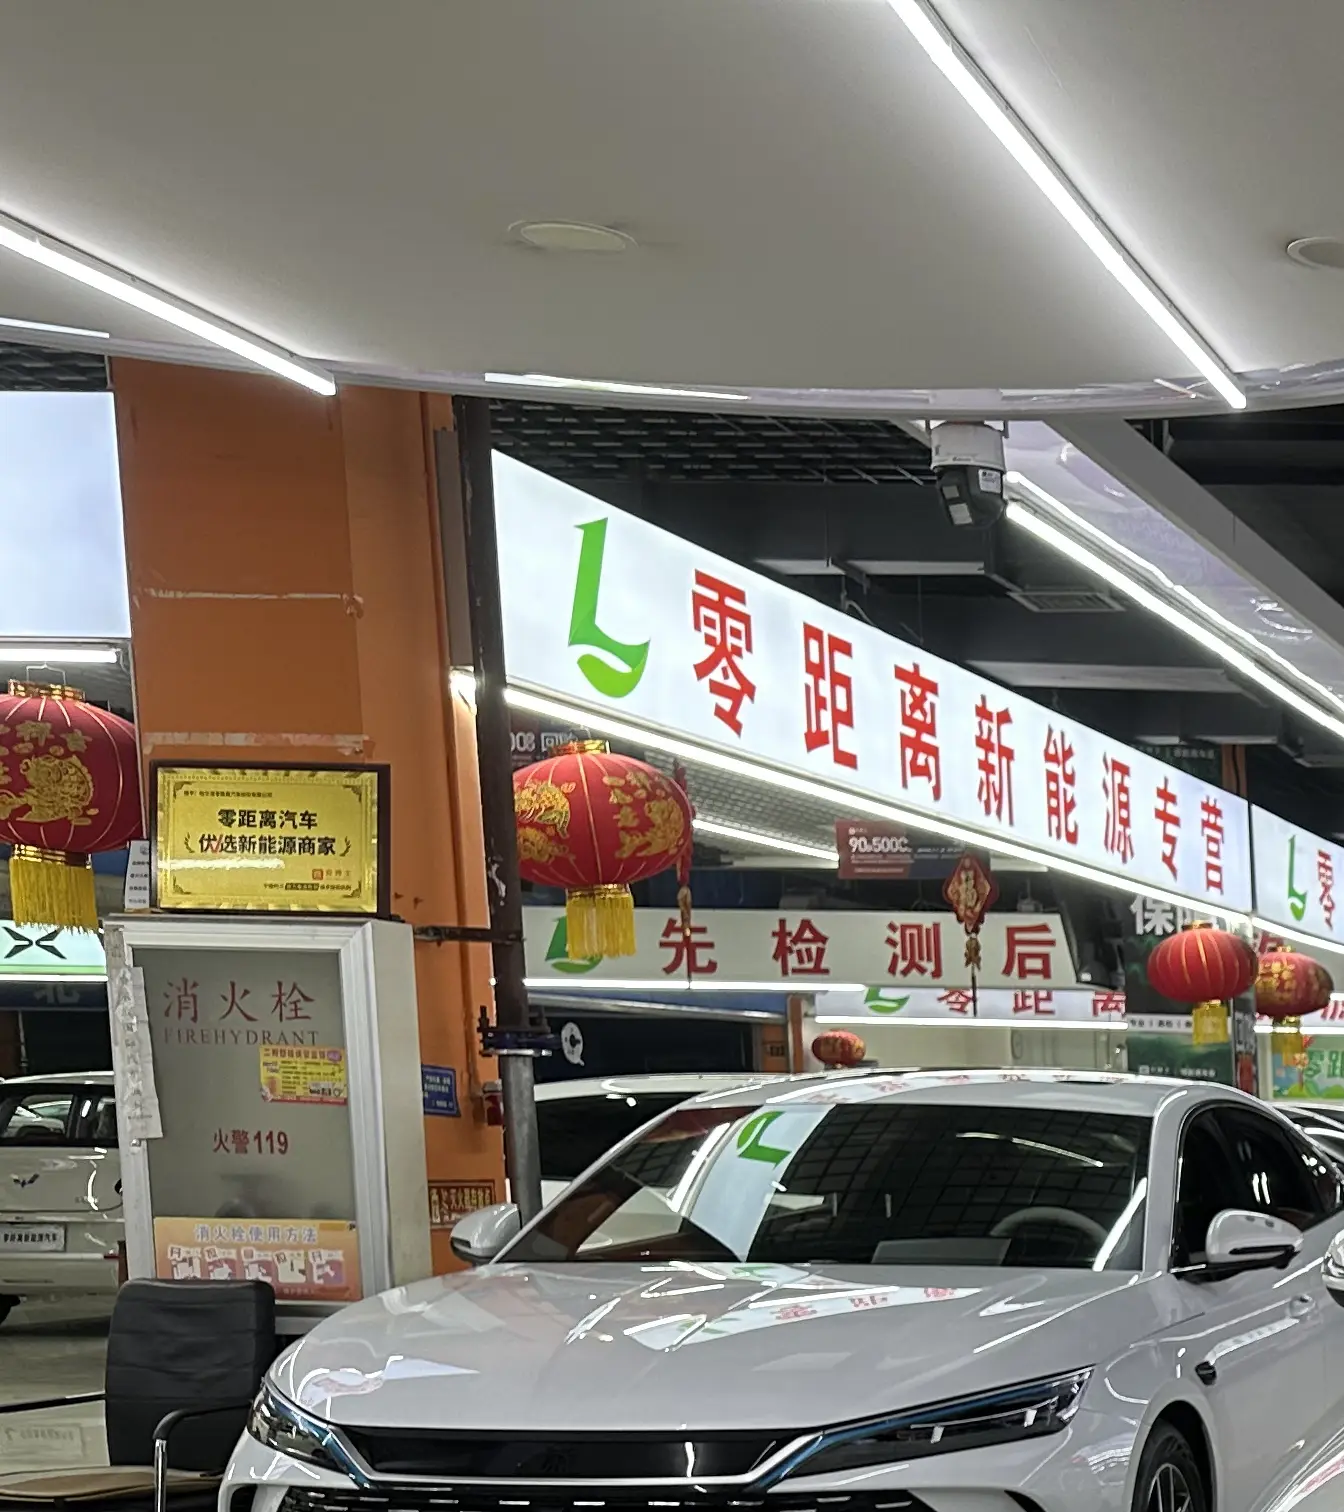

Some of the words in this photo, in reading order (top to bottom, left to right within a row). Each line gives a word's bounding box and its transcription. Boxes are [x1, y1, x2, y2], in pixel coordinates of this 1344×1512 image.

[691, 569, 1226, 895] 零距离新能源专营
[217, 809, 318, 829] 零距离汽车
[199, 834, 336, 856] 优选新能源商家
[659, 916, 1056, 979] 先检测后
[163, 977, 316, 1023] 消火栓
[164, 1028, 320, 1046] FIREHYDRANT
[213, 1128, 289, 1155] 火警119
